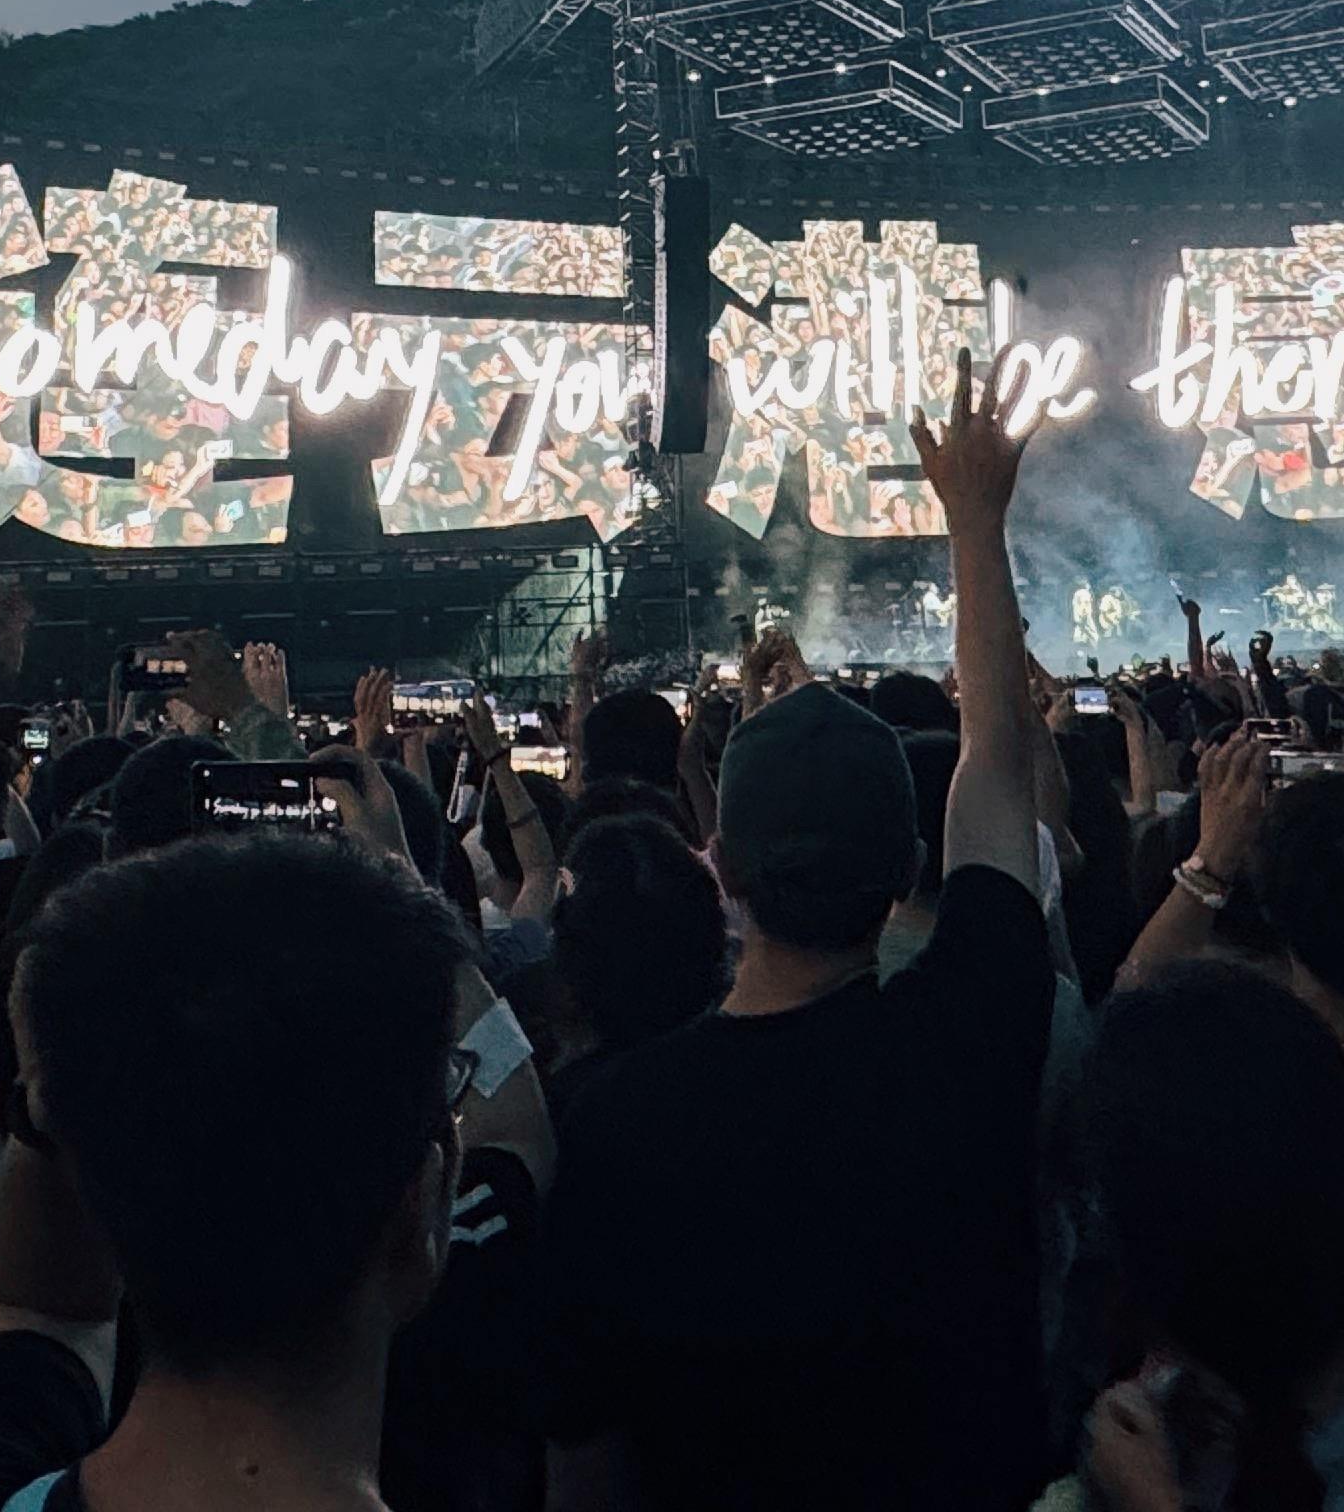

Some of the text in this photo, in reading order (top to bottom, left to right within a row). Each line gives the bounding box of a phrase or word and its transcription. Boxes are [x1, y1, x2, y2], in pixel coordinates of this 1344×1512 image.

[501, 335, 654, 502] you
[727, 260, 920, 421] will
[990, 277, 1097, 439] be
